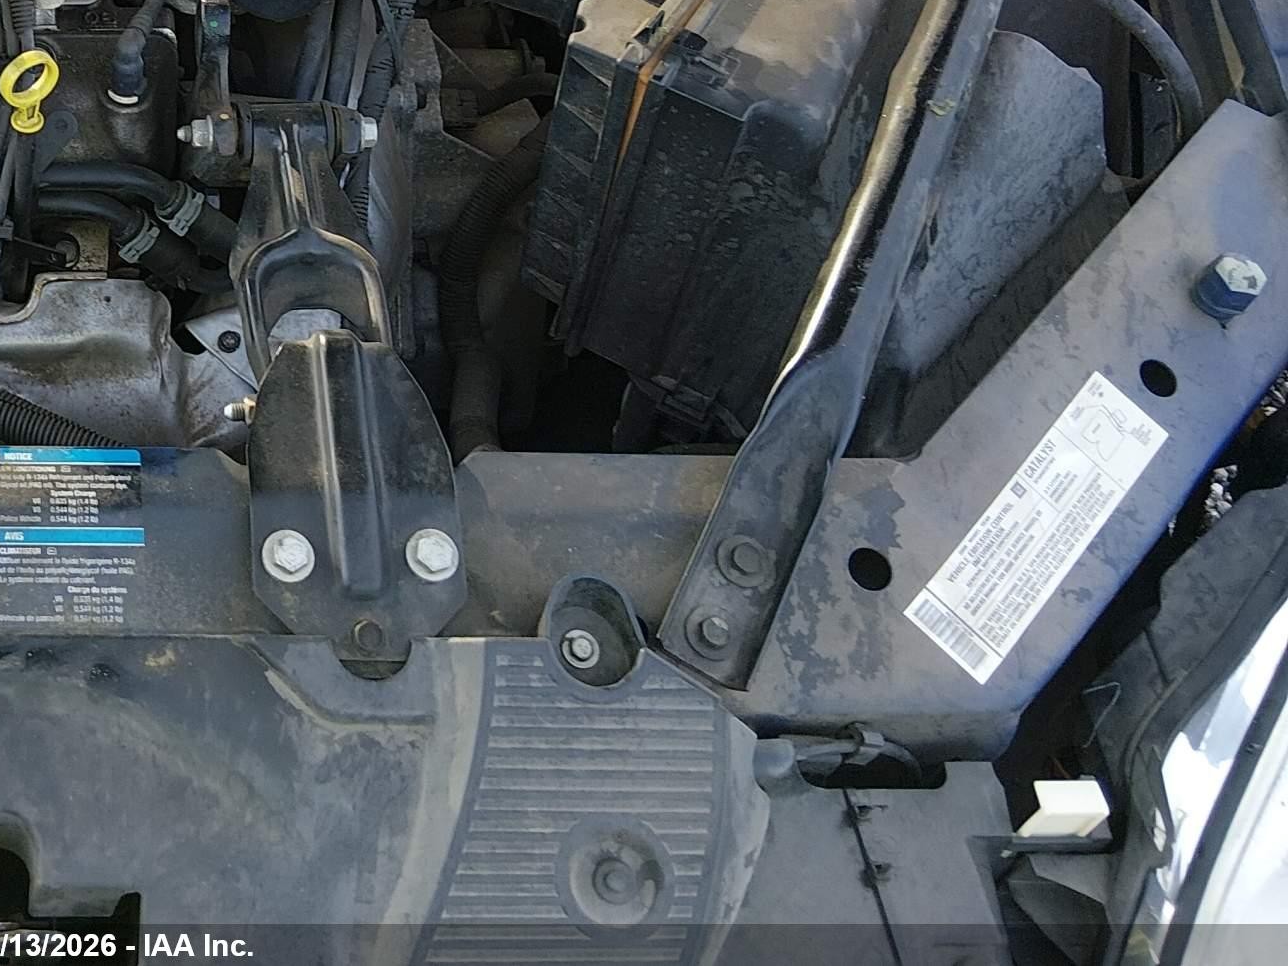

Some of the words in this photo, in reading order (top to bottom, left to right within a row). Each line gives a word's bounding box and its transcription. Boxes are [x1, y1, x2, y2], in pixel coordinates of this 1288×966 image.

[1022, 438, 1057, 479] CATALYST
[4, 531, 24, 541] AVIS
[946, 555, 970, 584] VEHICLE
[966, 526, 993, 558] EMISSION
[989, 500, 1014, 529] CONTROL
[971, 525, 1005, 568] INFORMATION
